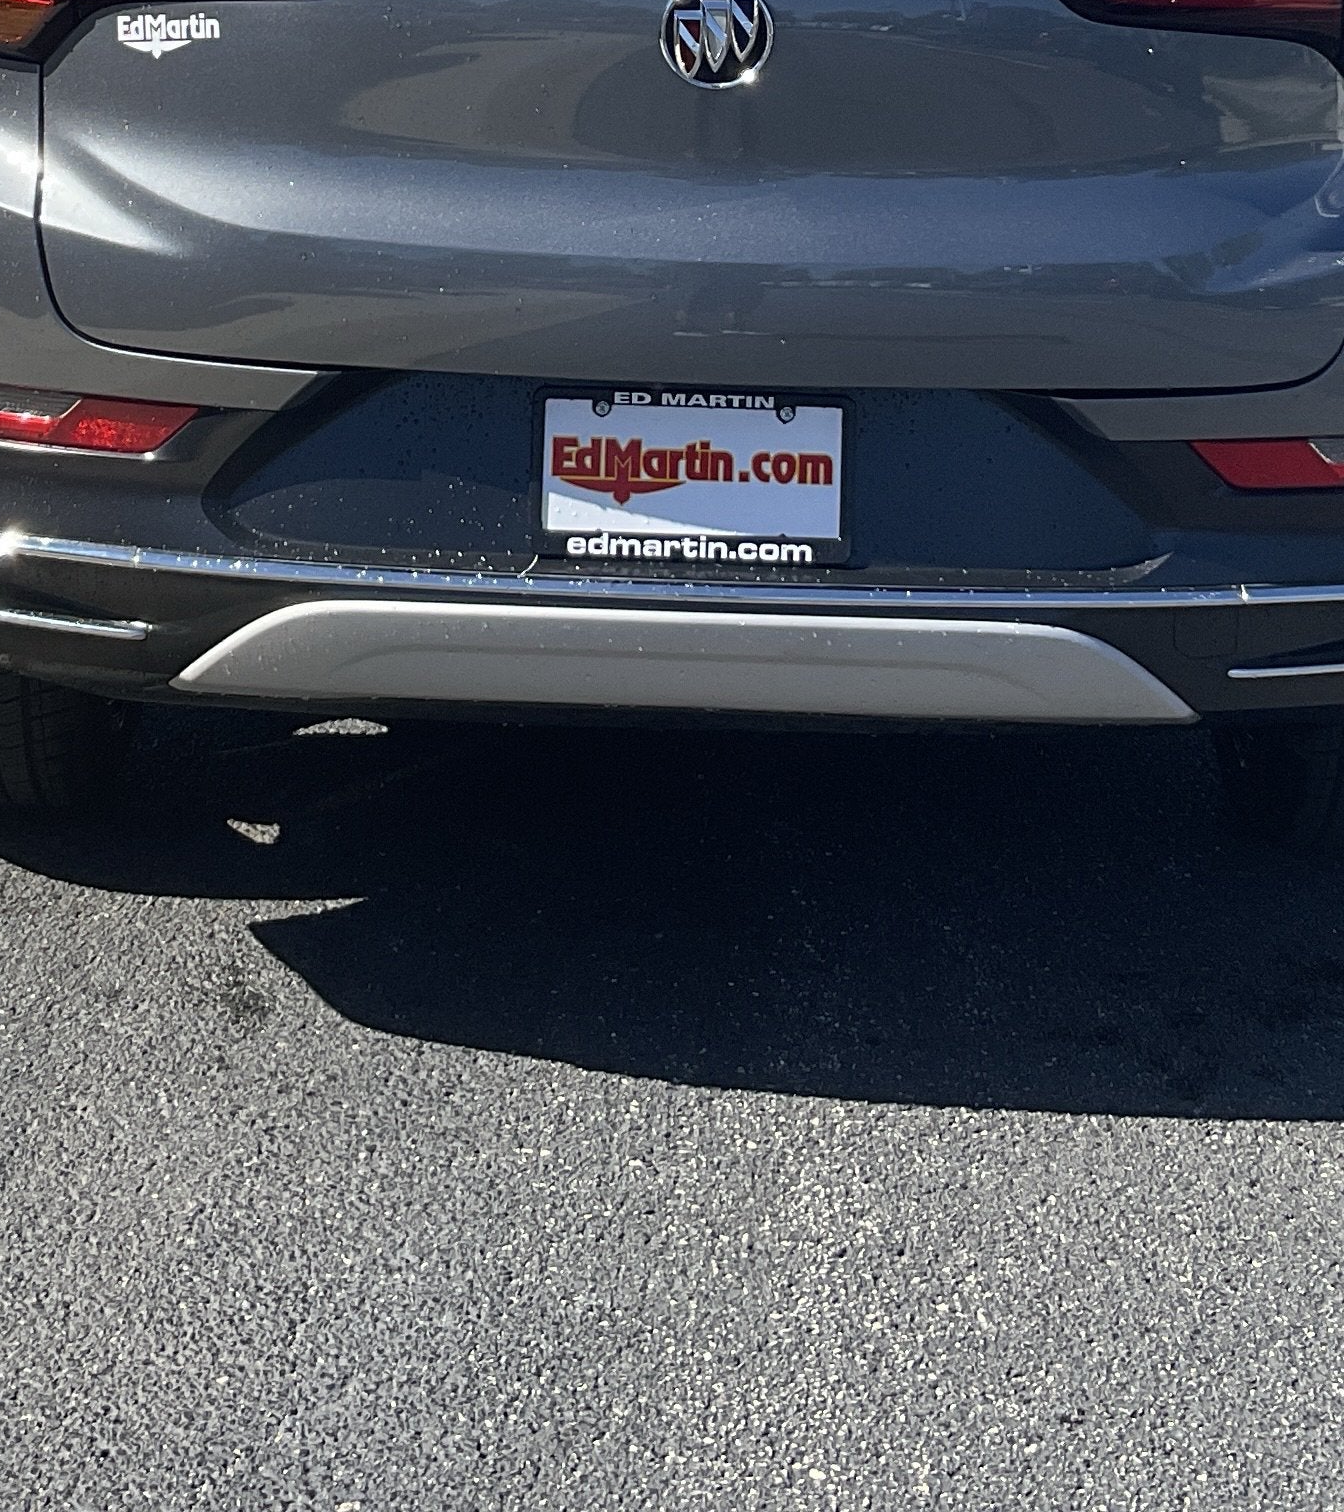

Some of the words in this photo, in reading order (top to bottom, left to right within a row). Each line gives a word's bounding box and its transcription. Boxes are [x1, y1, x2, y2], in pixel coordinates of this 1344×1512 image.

[117, 12, 220, 42] EdMartin
[614, 391, 652, 405] ED
[661, 392, 775, 409] MARTIN
[551, 435, 834, 487] EdMartin.com
[566, 534, 813, 562] edmartin.com
